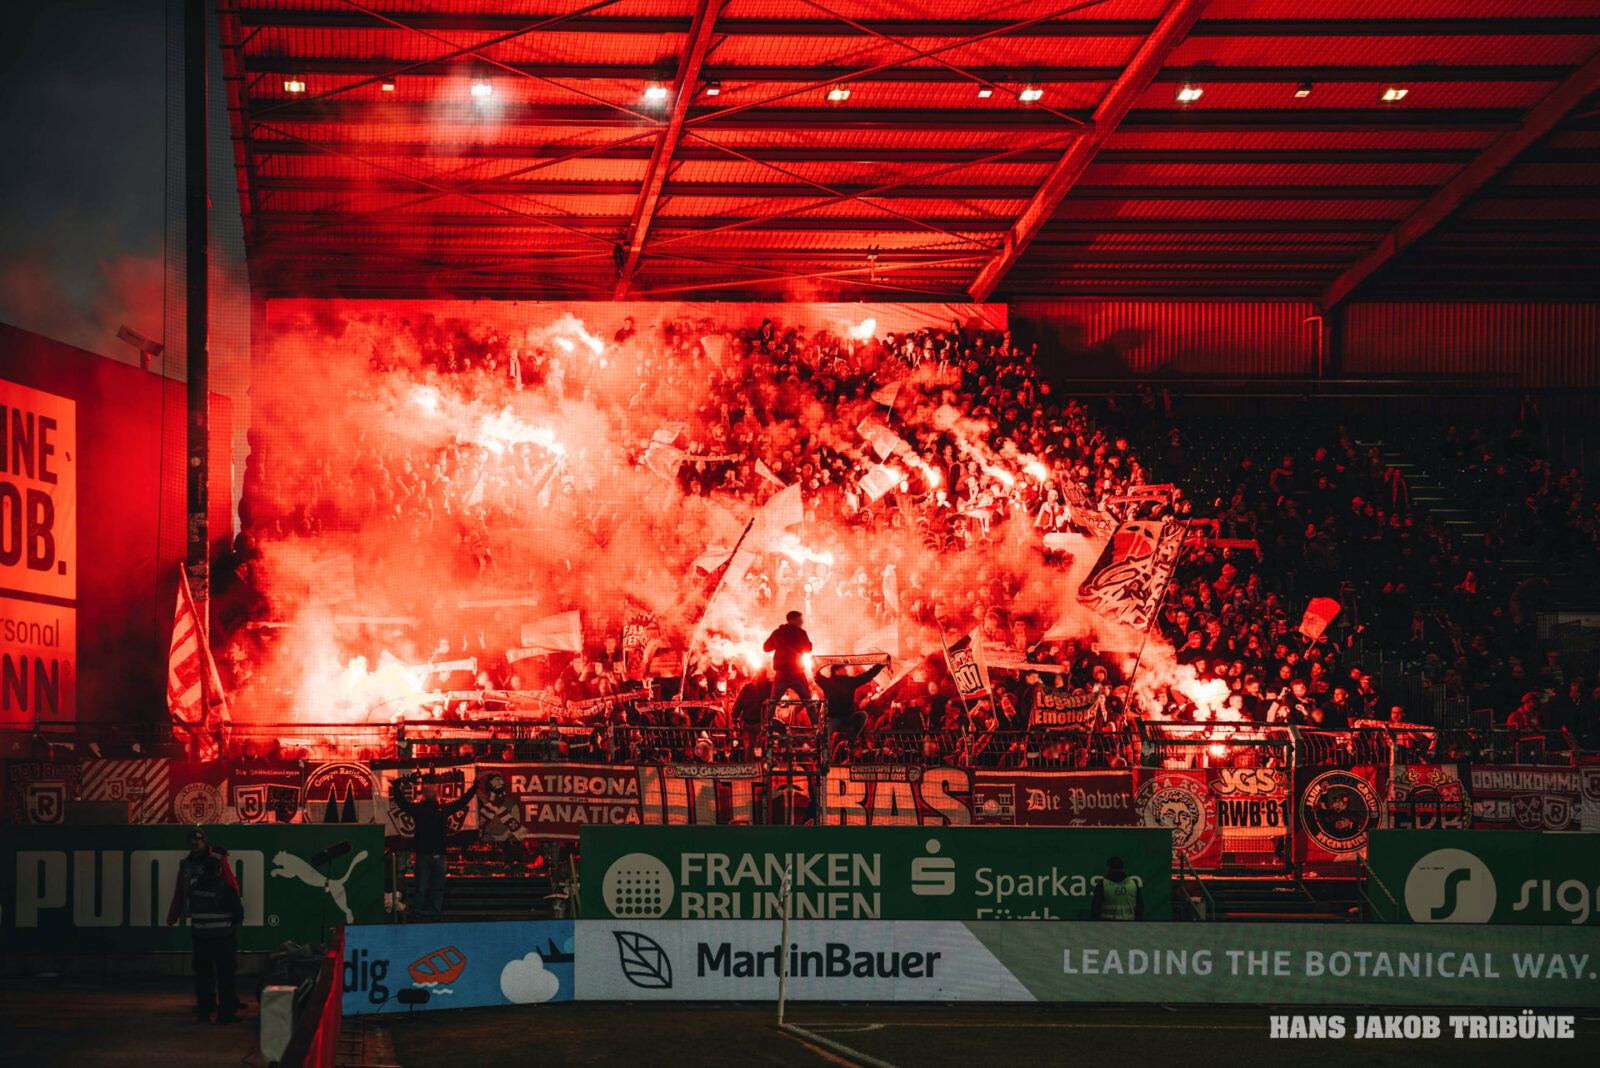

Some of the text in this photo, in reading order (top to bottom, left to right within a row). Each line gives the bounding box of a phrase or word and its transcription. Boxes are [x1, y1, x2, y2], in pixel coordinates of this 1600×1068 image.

[0, 617, 60, 648] sonal
[511, 774, 638, 796] RATISBONA
[1209, 767, 1277, 796] JGS
[524, 804, 641, 825] FANATICA
[1025, 786, 1130, 814] Die Power
[680, 852, 881, 886] FRANKEN
[16, 850, 264, 927] PUMA
[1114, 886, 1127, 897] 60
[697, 942, 941, 978] MartinBauer
[1063, 949, 1598, 980] LEADING THE BOTANICAL WAY.
